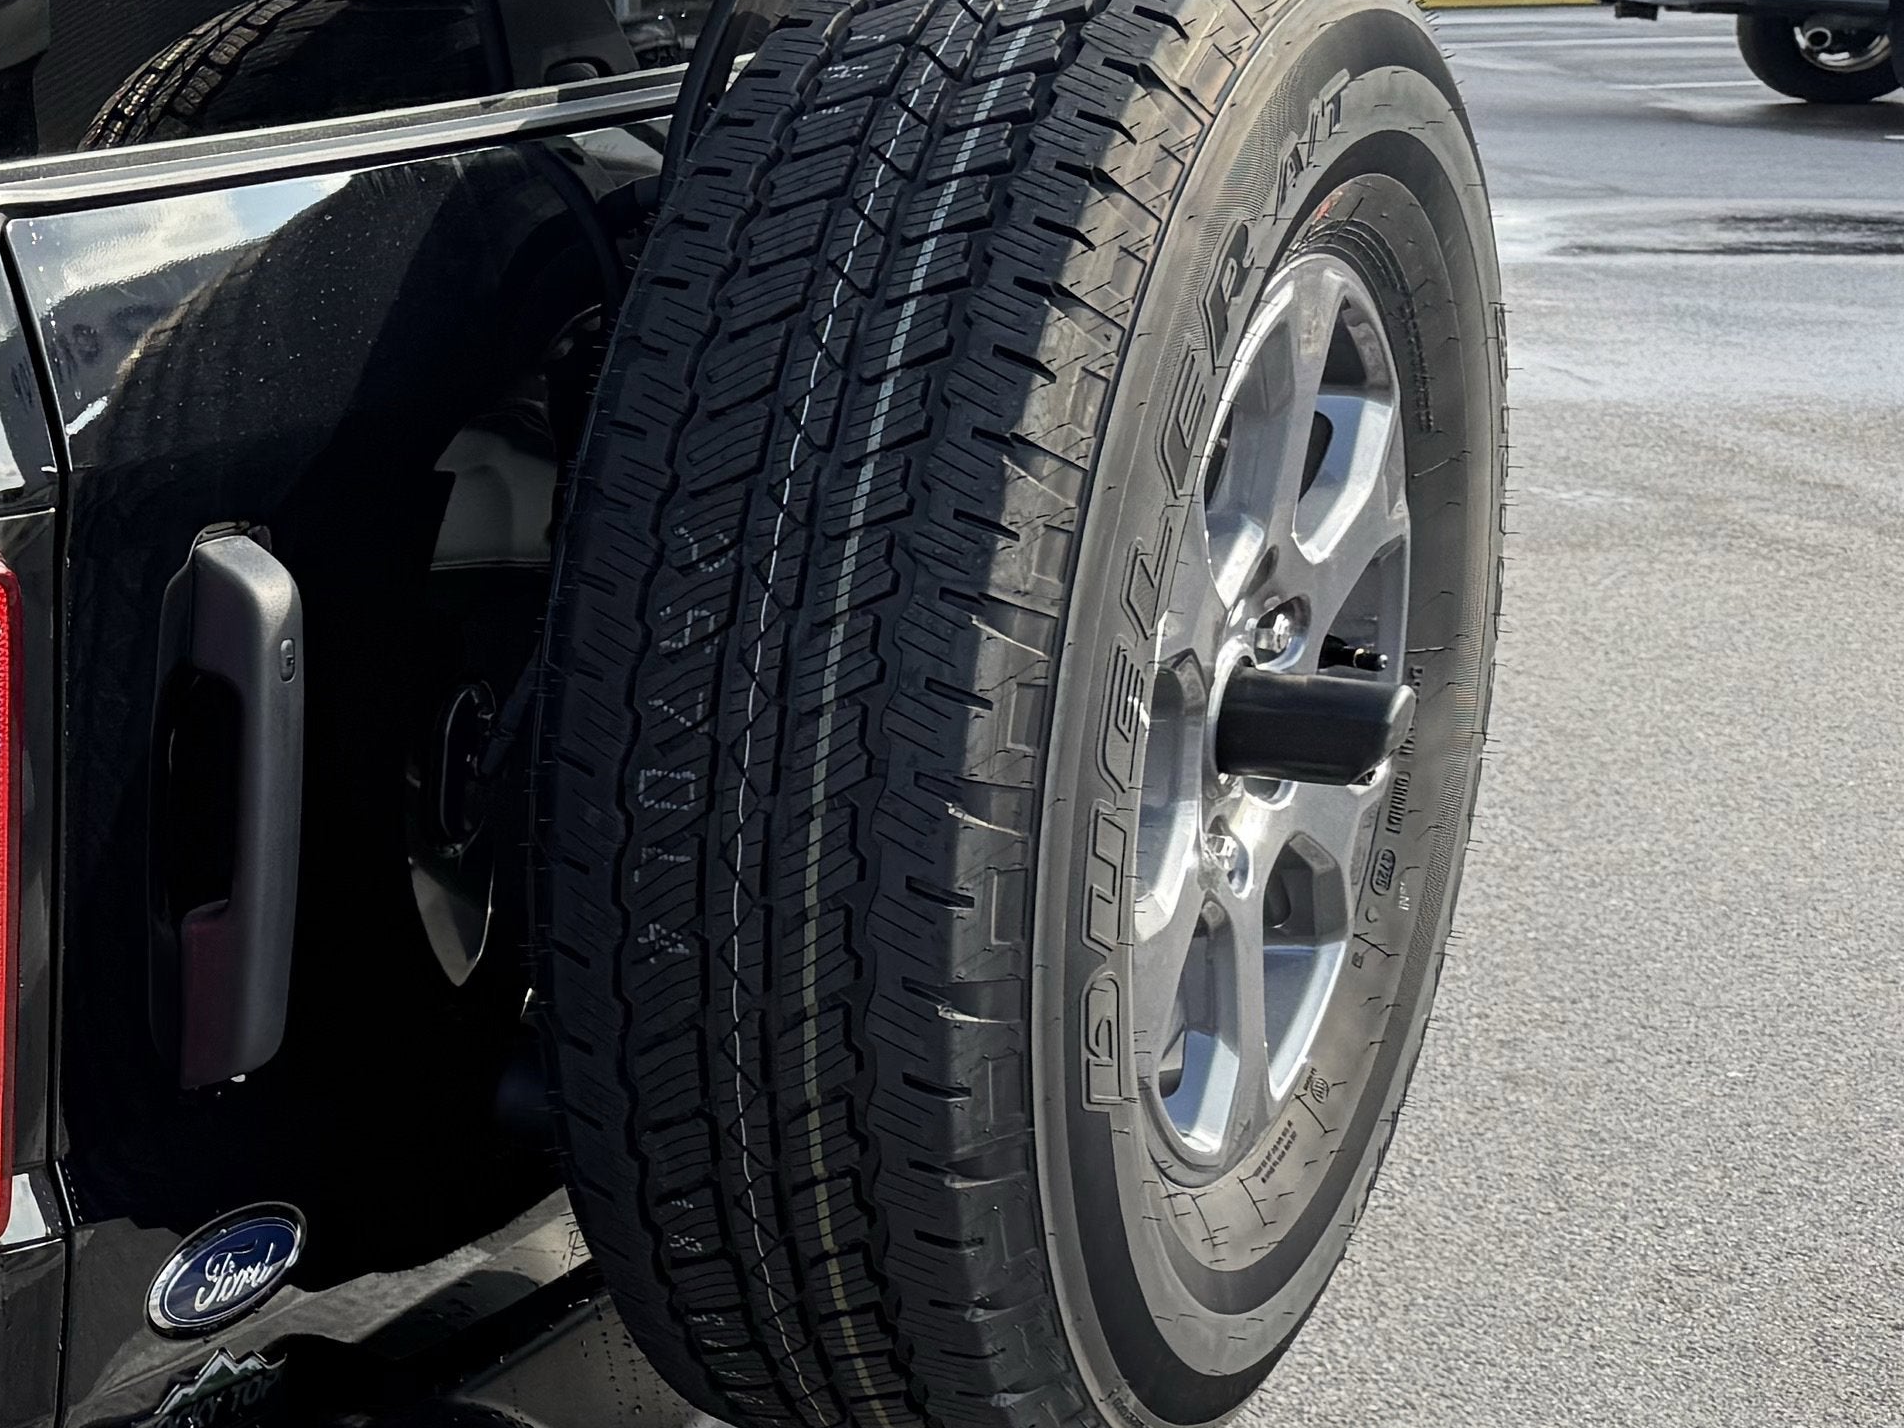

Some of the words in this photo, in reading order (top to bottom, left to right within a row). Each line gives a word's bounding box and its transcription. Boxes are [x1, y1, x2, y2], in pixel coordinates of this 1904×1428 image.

[1082, 218, 1252, 1112] DUELER
[1274, 68, 1351, 225] A/T
[194, 1239, 276, 1313] Ford
